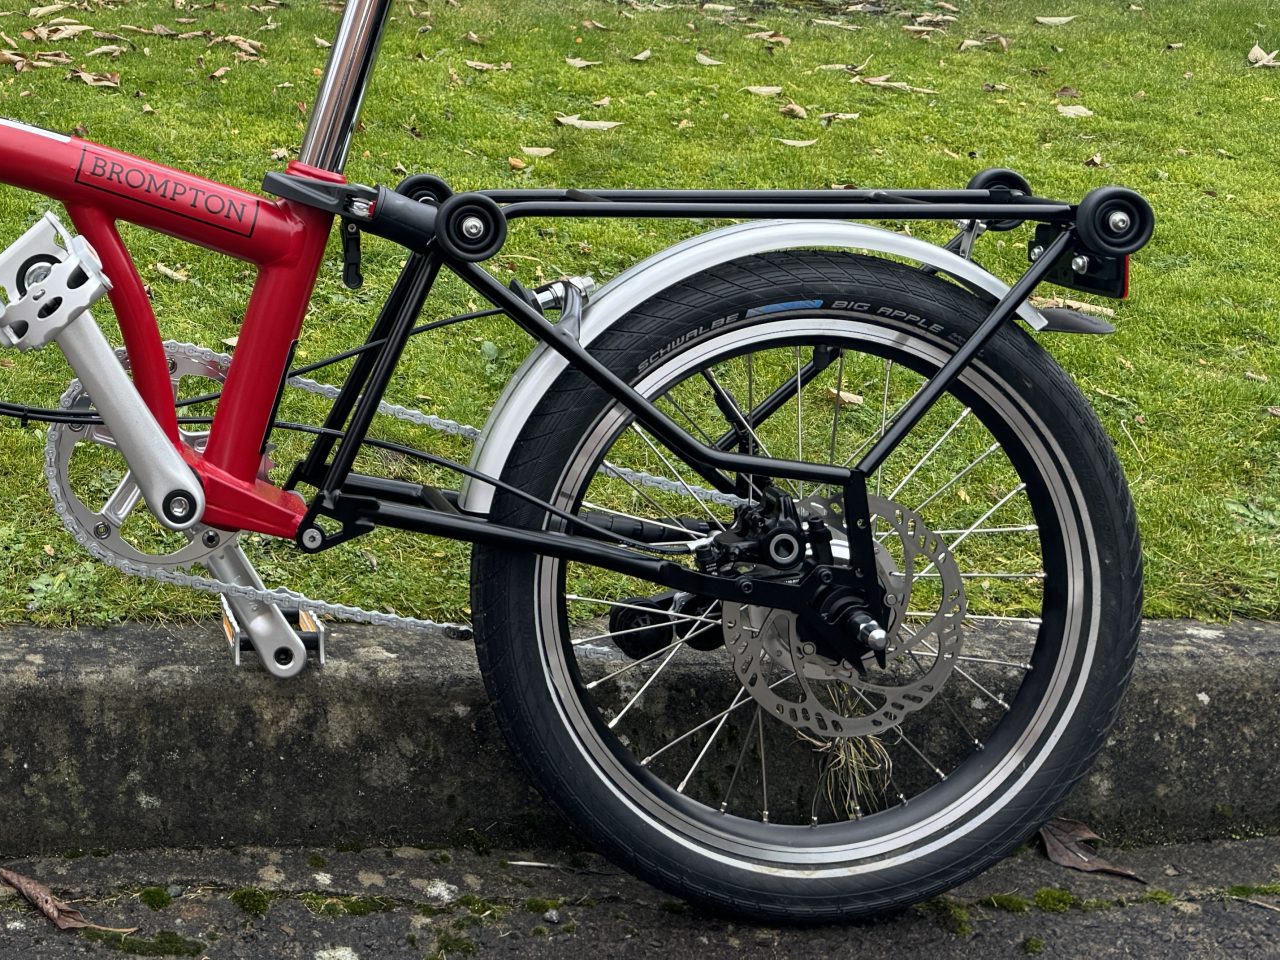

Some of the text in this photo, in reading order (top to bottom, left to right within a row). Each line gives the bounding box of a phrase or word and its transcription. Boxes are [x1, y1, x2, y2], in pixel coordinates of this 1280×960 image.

[90, 155, 247, 223] BROMPTON
[636, 300, 945, 374] SCHWALBE BIG APPLE
